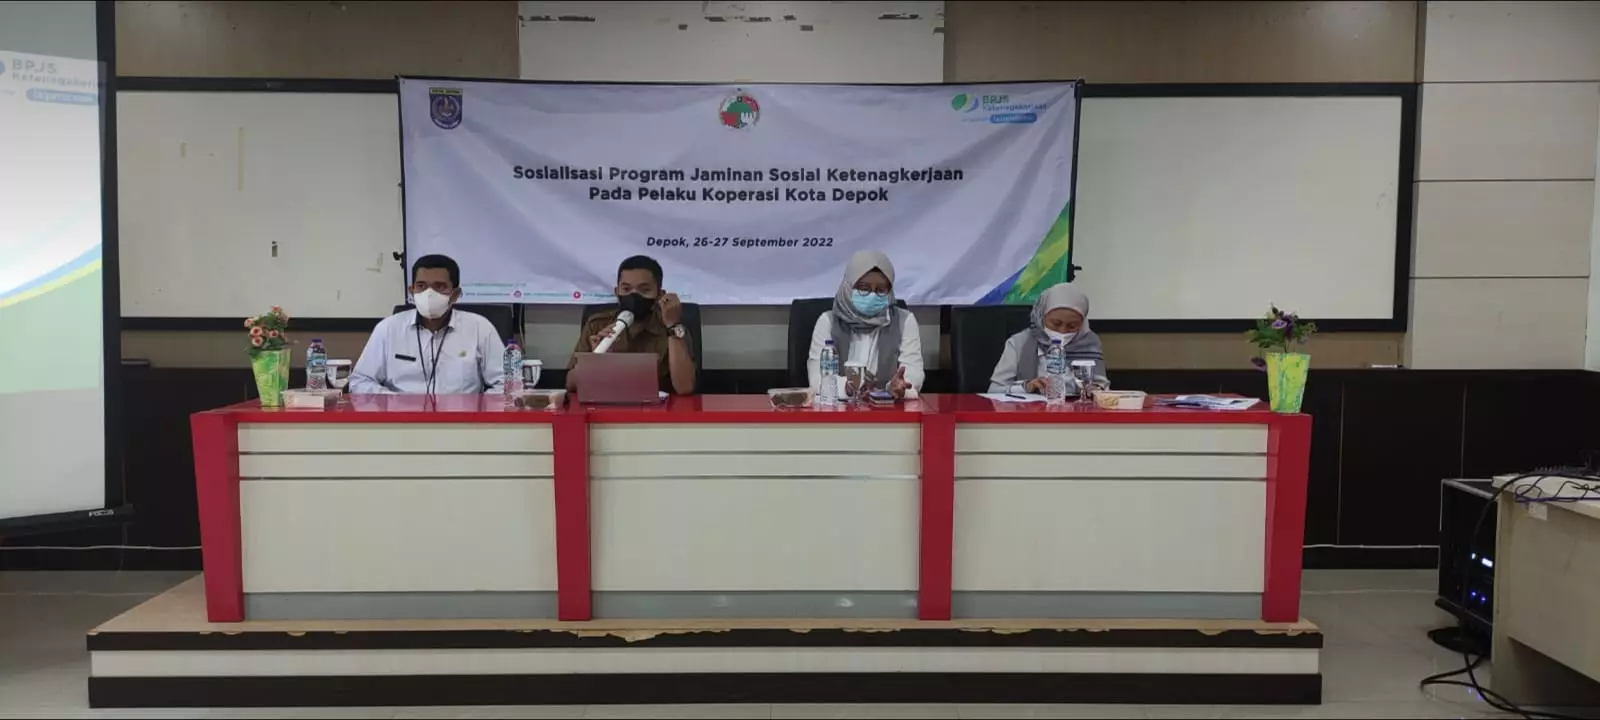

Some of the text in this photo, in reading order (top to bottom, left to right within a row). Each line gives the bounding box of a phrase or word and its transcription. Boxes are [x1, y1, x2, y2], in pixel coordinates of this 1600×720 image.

[12, 58, 57, 74] BPJS
[512, 165, 964, 184] Sosialisasi Program Jaminan Sosial Ketenagkerjaan
[589, 187, 889, 204] Pada Pelaku Koperasi Kota Depok
[646, 236, 834, 250] Depok, 26-27 September 2022
